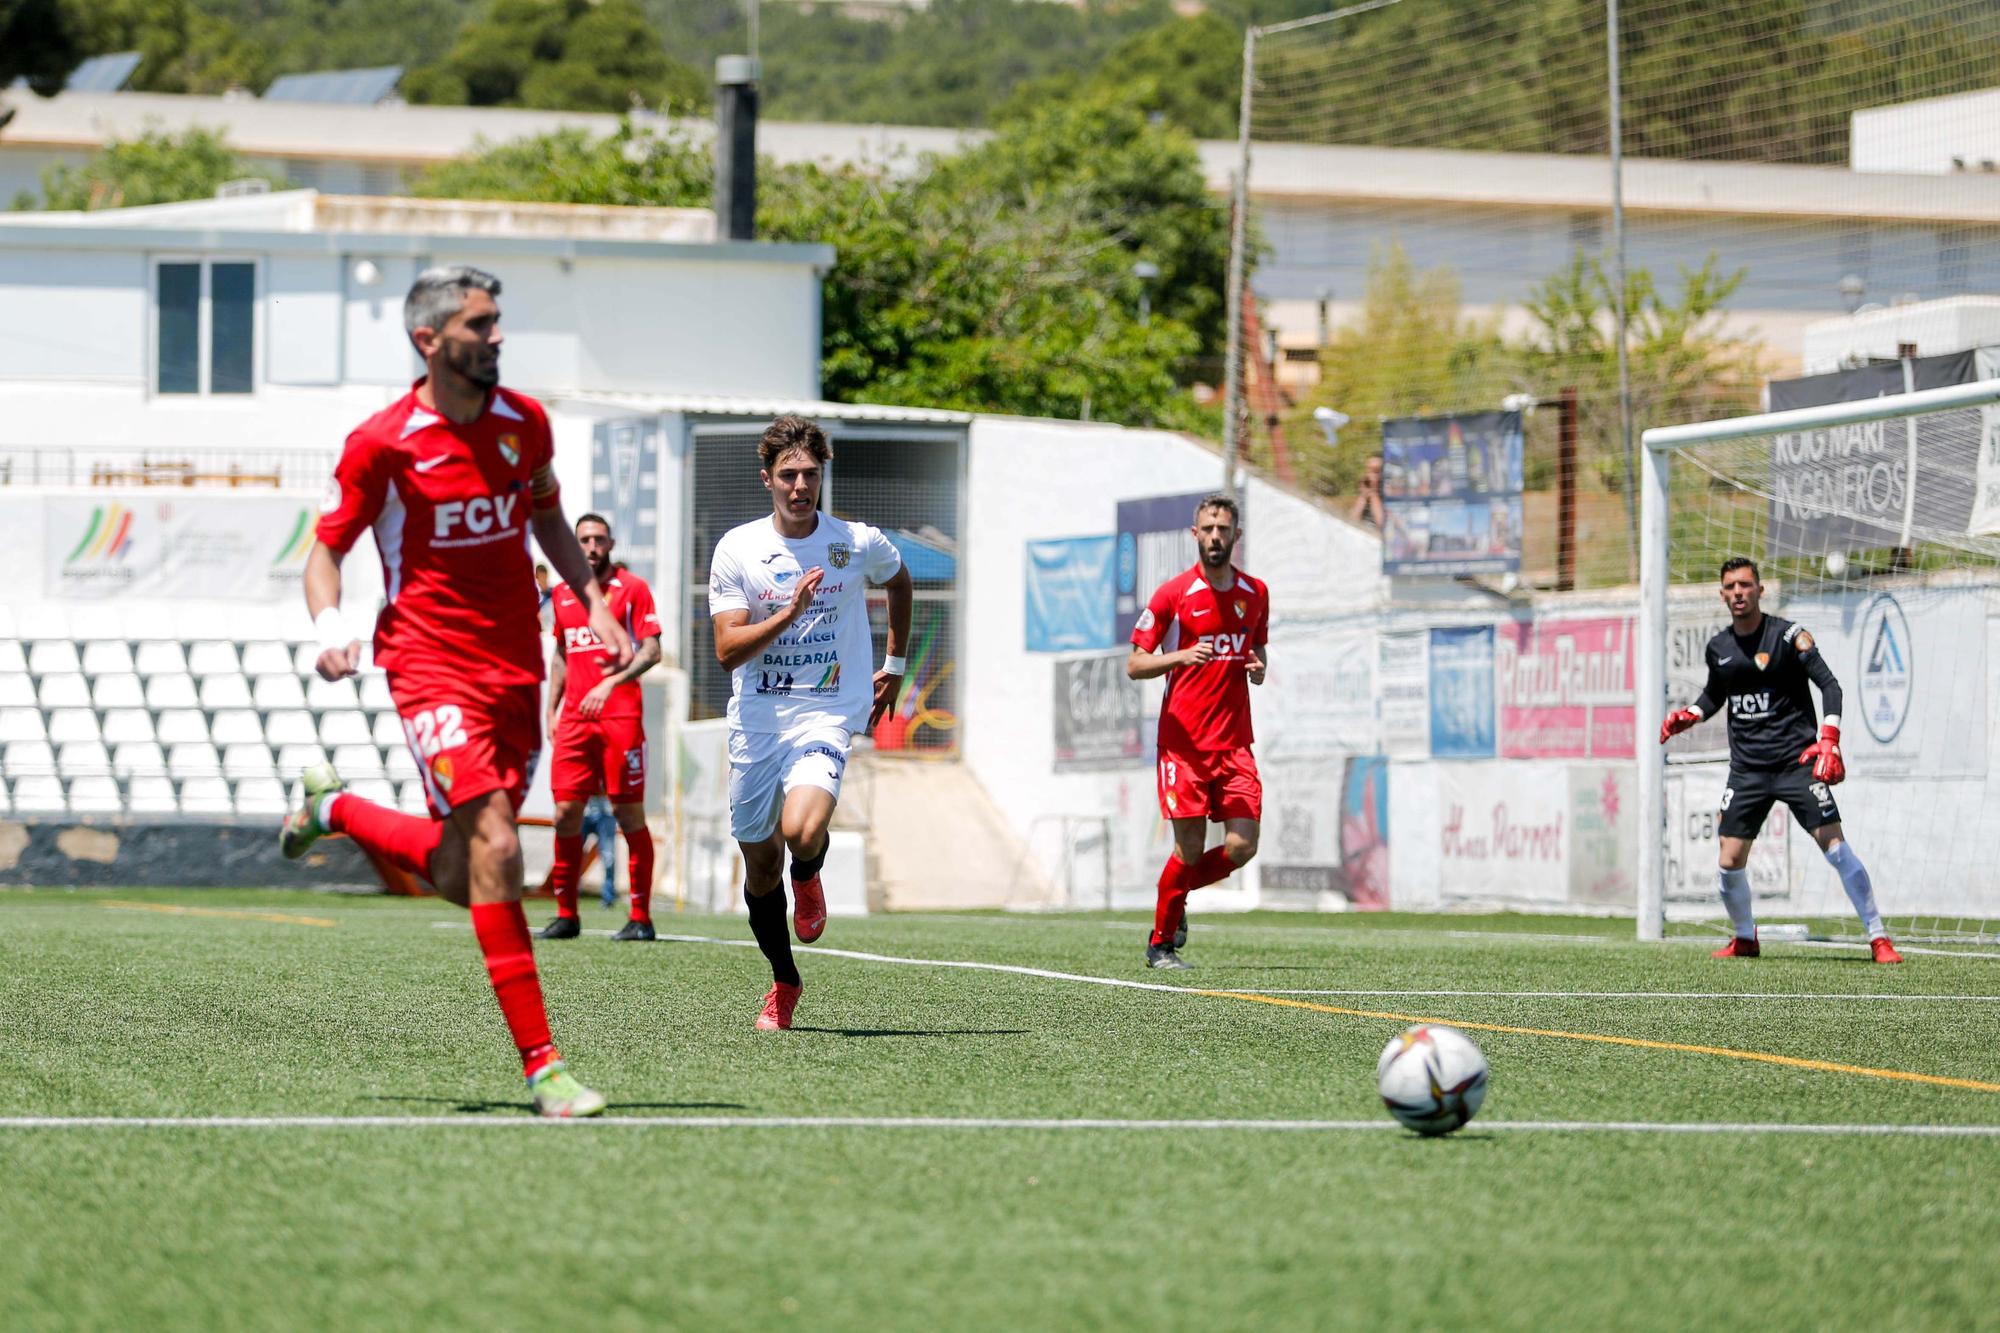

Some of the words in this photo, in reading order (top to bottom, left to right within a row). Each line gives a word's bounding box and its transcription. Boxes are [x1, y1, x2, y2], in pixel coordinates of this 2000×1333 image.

[434, 493, 517, 537] FCV
[772, 632, 836, 645] nfinitel
[1730, 692, 1771, 714] FCV
[413, 704, 468, 758] 22
